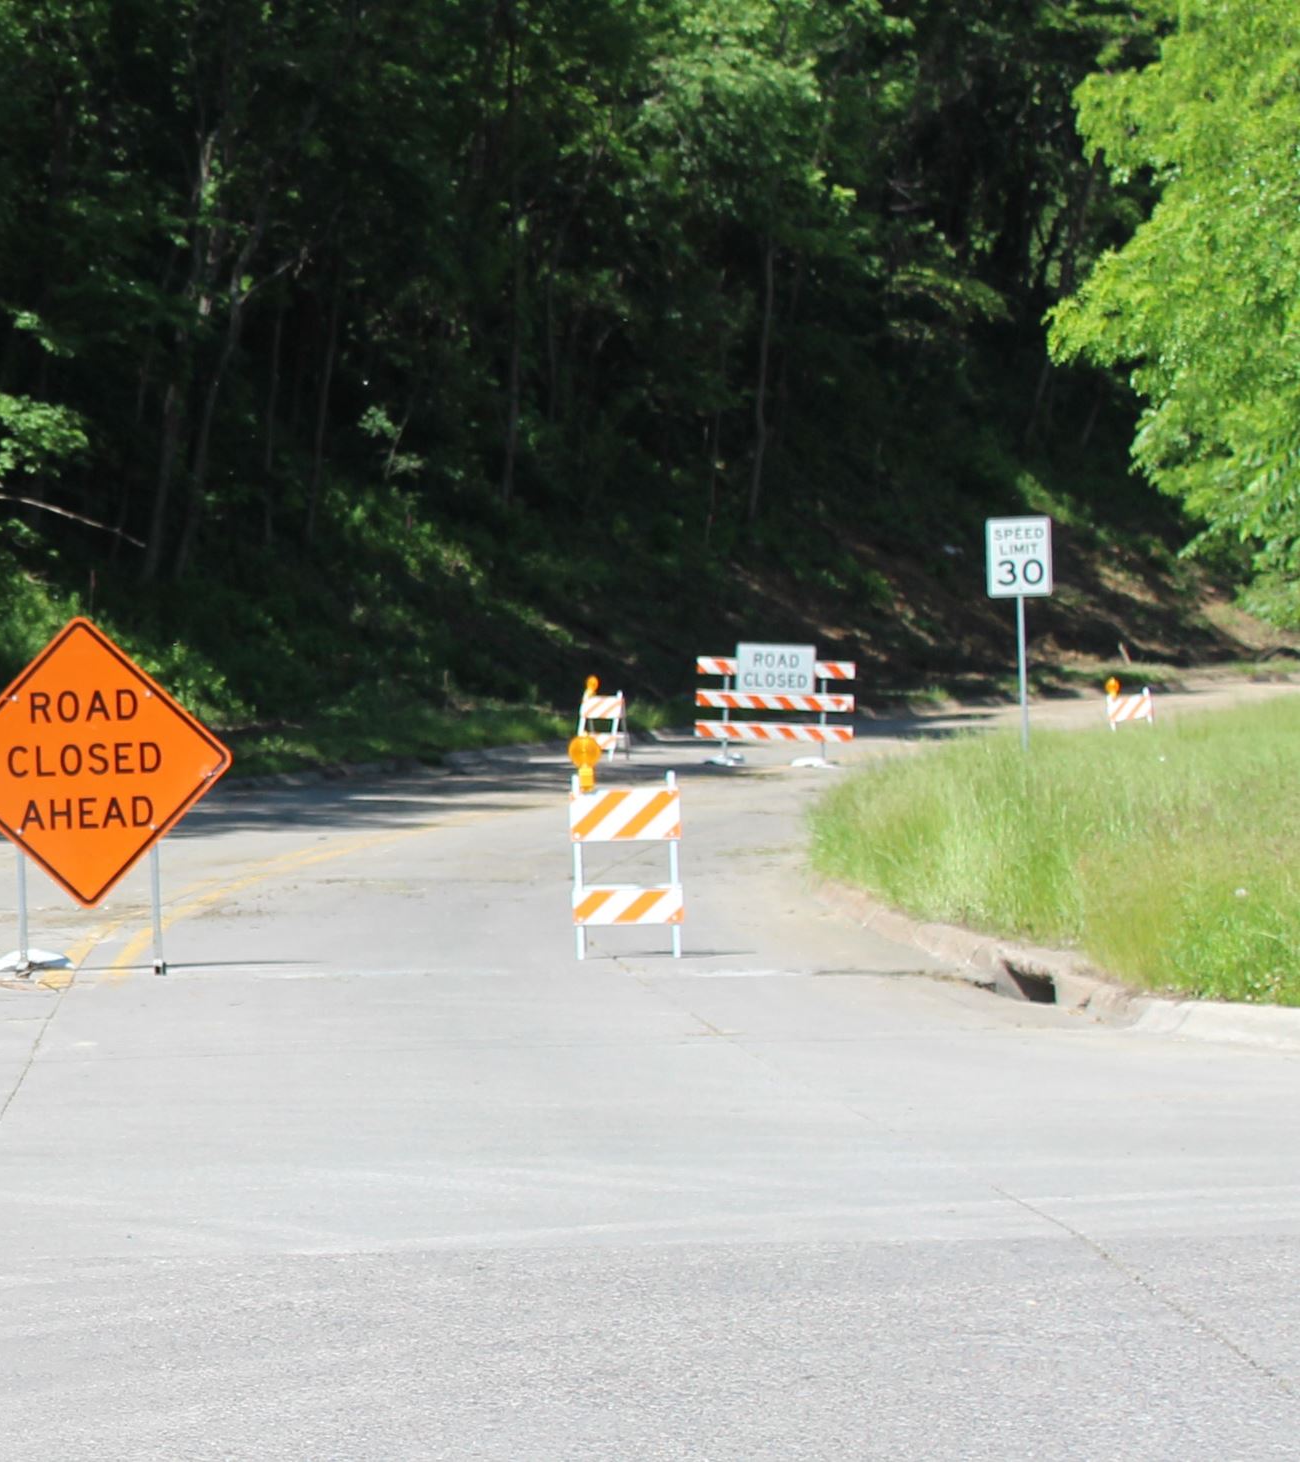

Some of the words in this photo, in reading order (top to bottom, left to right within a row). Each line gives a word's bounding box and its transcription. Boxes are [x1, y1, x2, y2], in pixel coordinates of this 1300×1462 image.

[994, 527, 1044, 541] SPEED
[999, 543, 1038, 556] LIMIT
[998, 559, 1044, 586] 30
[752, 652, 800, 669] ROAD
[743, 671, 808, 689] CLOSED
[29, 689, 139, 724] ROAD
[6, 742, 162, 778] CLOSED
[20, 796, 154, 831] AHEAD
